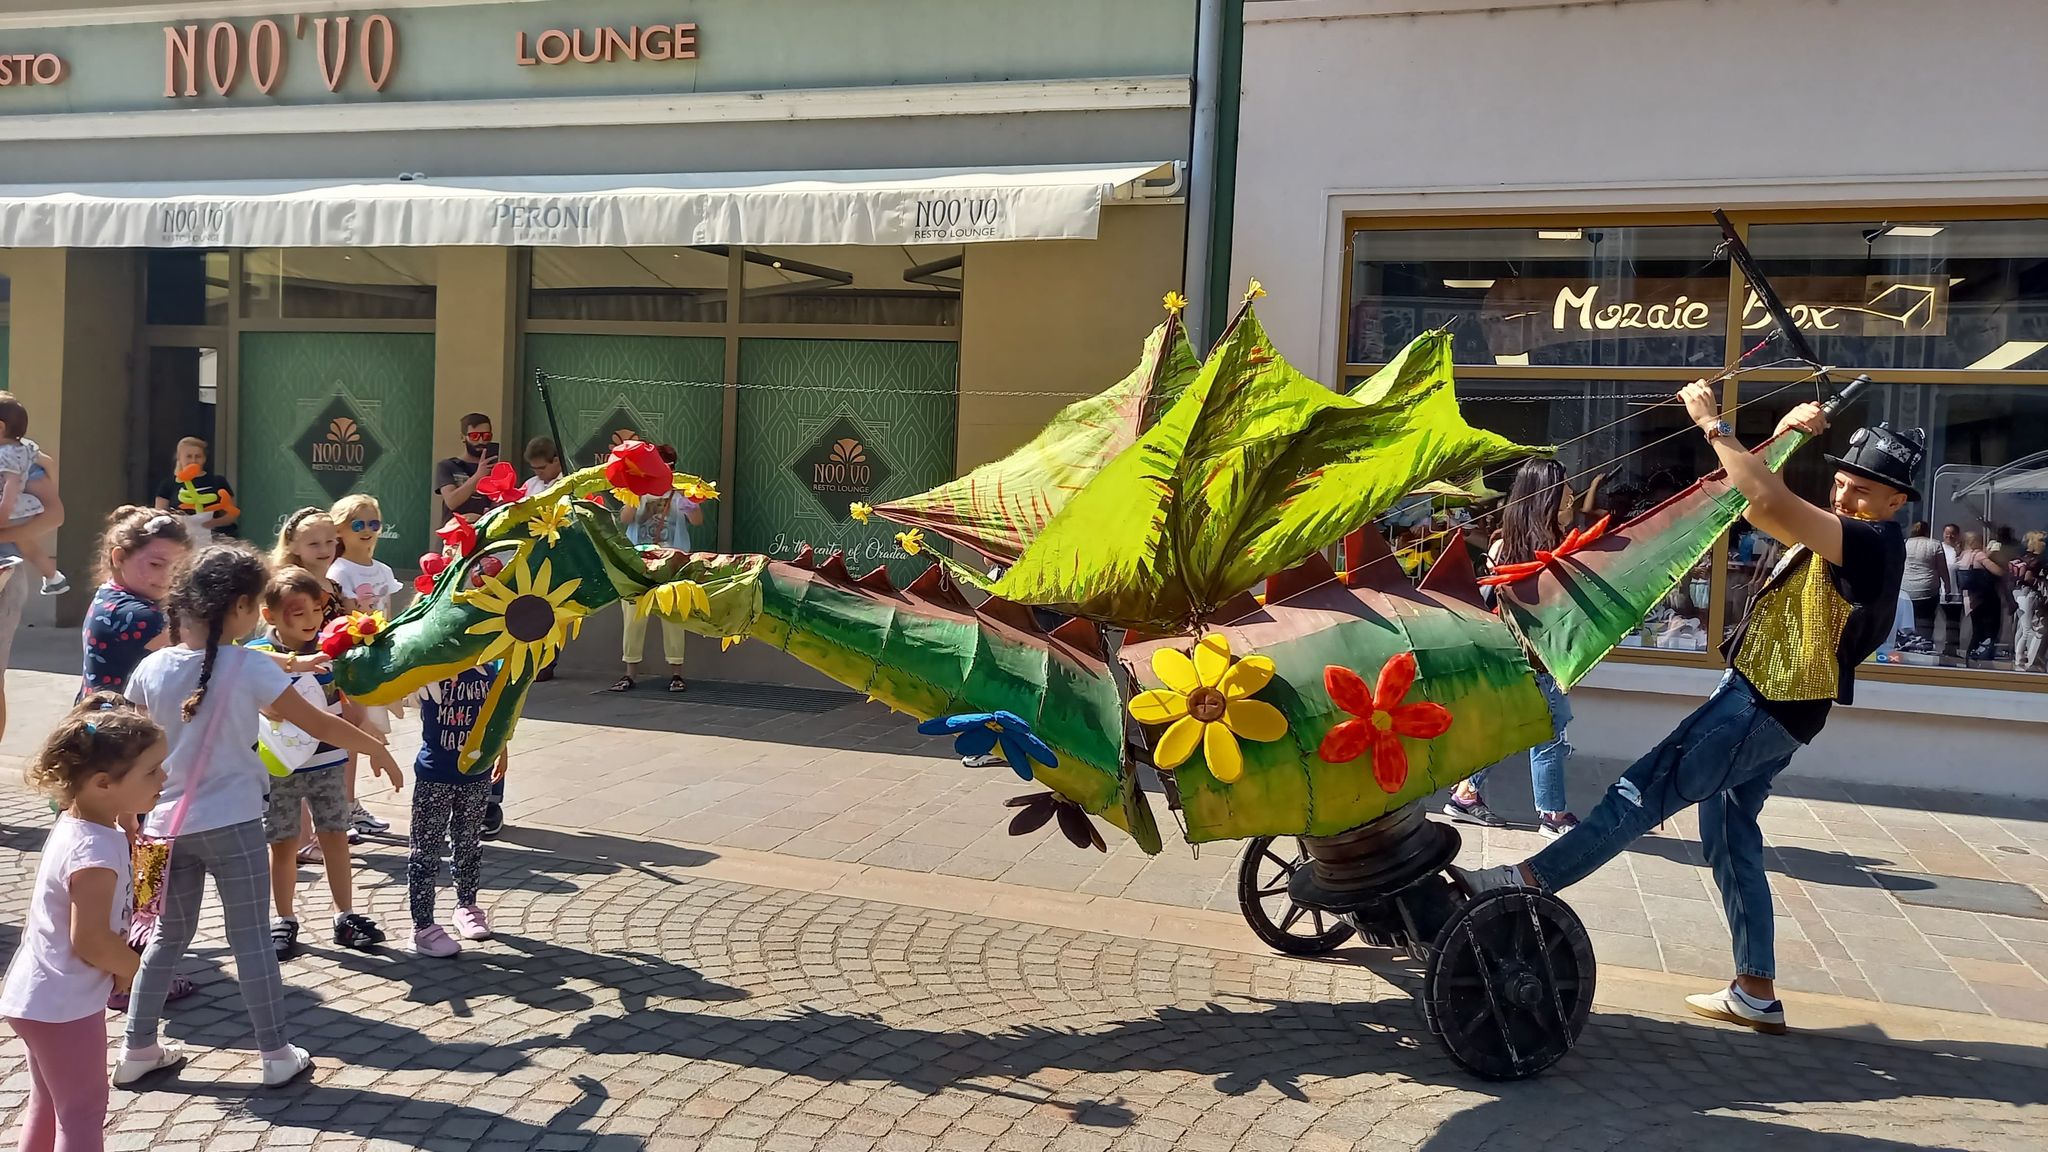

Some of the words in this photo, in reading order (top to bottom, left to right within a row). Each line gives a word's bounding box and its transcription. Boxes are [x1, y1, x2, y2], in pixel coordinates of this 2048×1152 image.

[163, 14, 394, 97] NOO'VO
[515, 23, 696, 65] LOUNGE
[492, 204, 590, 228] PERONI
[915, 198, 997, 227] NOO'VO
[914, 229, 947, 239] RESTO
[950, 227, 996, 238] LOUNGE
[837, 485, 870, 493] LOUNGE
[769, 534, 790, 555] In
[846, 543, 861, 563] of
[866, 537, 908, 559] Oradea
